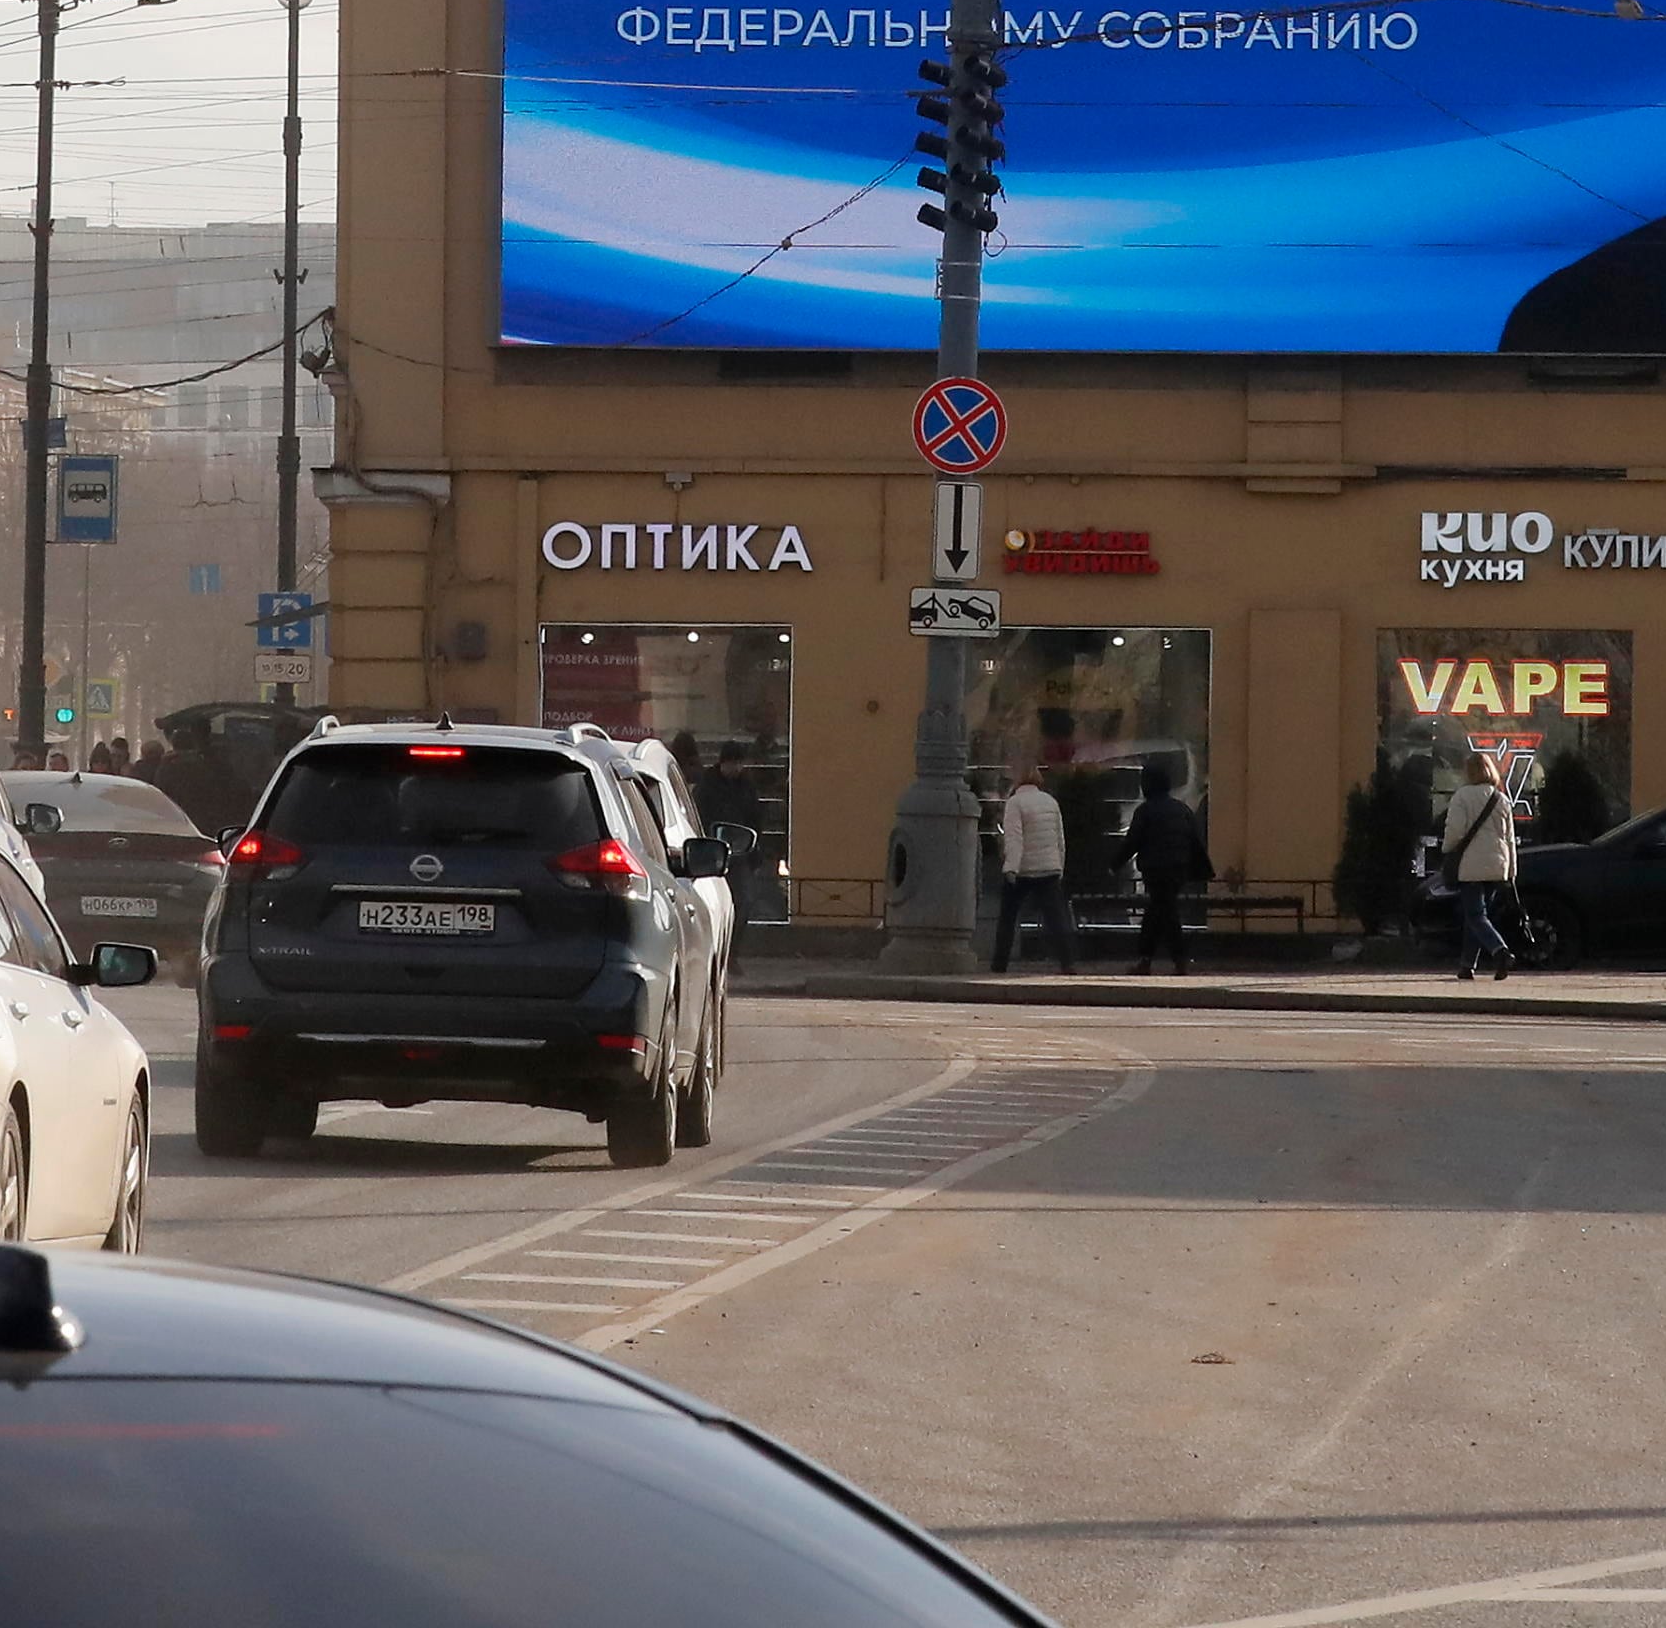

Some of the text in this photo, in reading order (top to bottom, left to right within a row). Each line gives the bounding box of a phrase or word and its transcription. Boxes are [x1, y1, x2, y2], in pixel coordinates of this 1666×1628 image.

[1098, 9, 1419, 53] СОБРАНИЮ
[542, 522, 813, 572] ОПТИКА
[1398, 658, 1612, 717] VAPE
